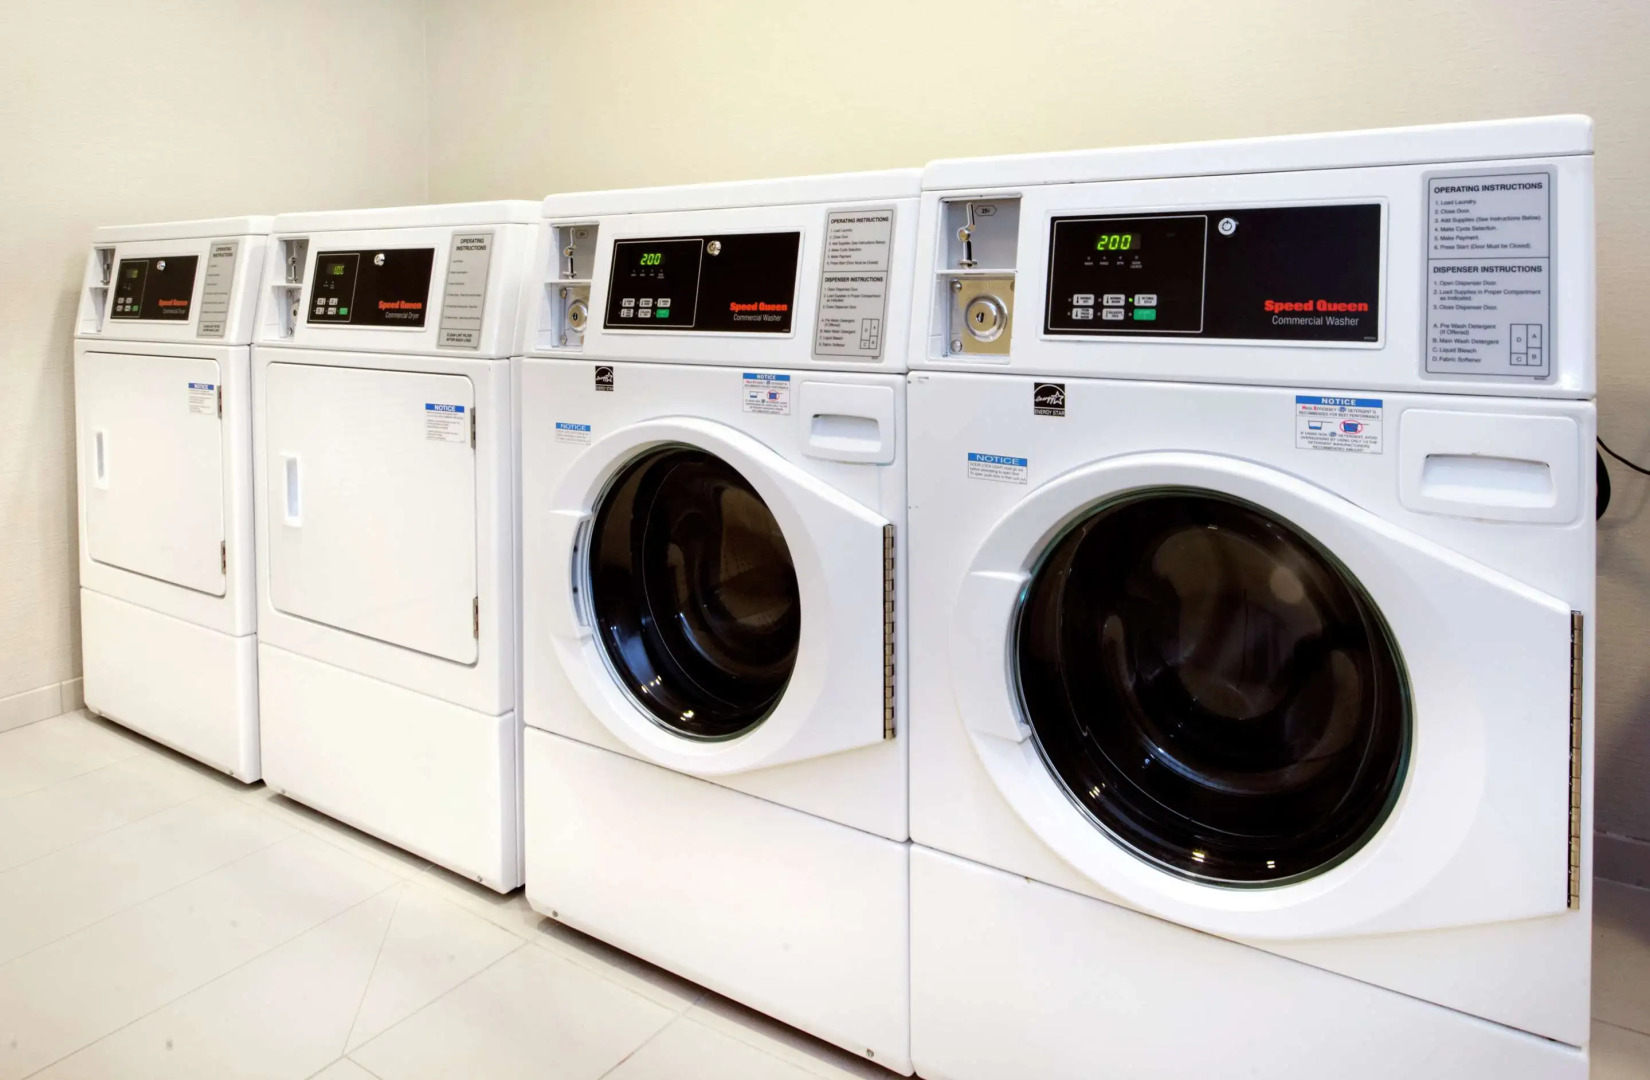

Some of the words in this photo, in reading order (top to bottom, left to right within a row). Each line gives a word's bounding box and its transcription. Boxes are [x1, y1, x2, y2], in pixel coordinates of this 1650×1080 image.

[1434, 185, 1480, 194] OPERATING
[1482, 182, 1542, 192] INSTRUCTIONS
[1097, 235, 1131, 250] 200
[640, 254, 661, 265] 200
[378, 300, 399, 310] Speed
[730, 302, 758, 312] Speed
[759, 302, 787, 311] Queen
[1264, 300, 1313, 313] Speed
[1316, 300, 1368, 312] Queen
[1272, 315, 1323, 325] Commercial
[1326, 316, 1359, 326] Washer
[977, 455, 1019, 465] NOTICE
